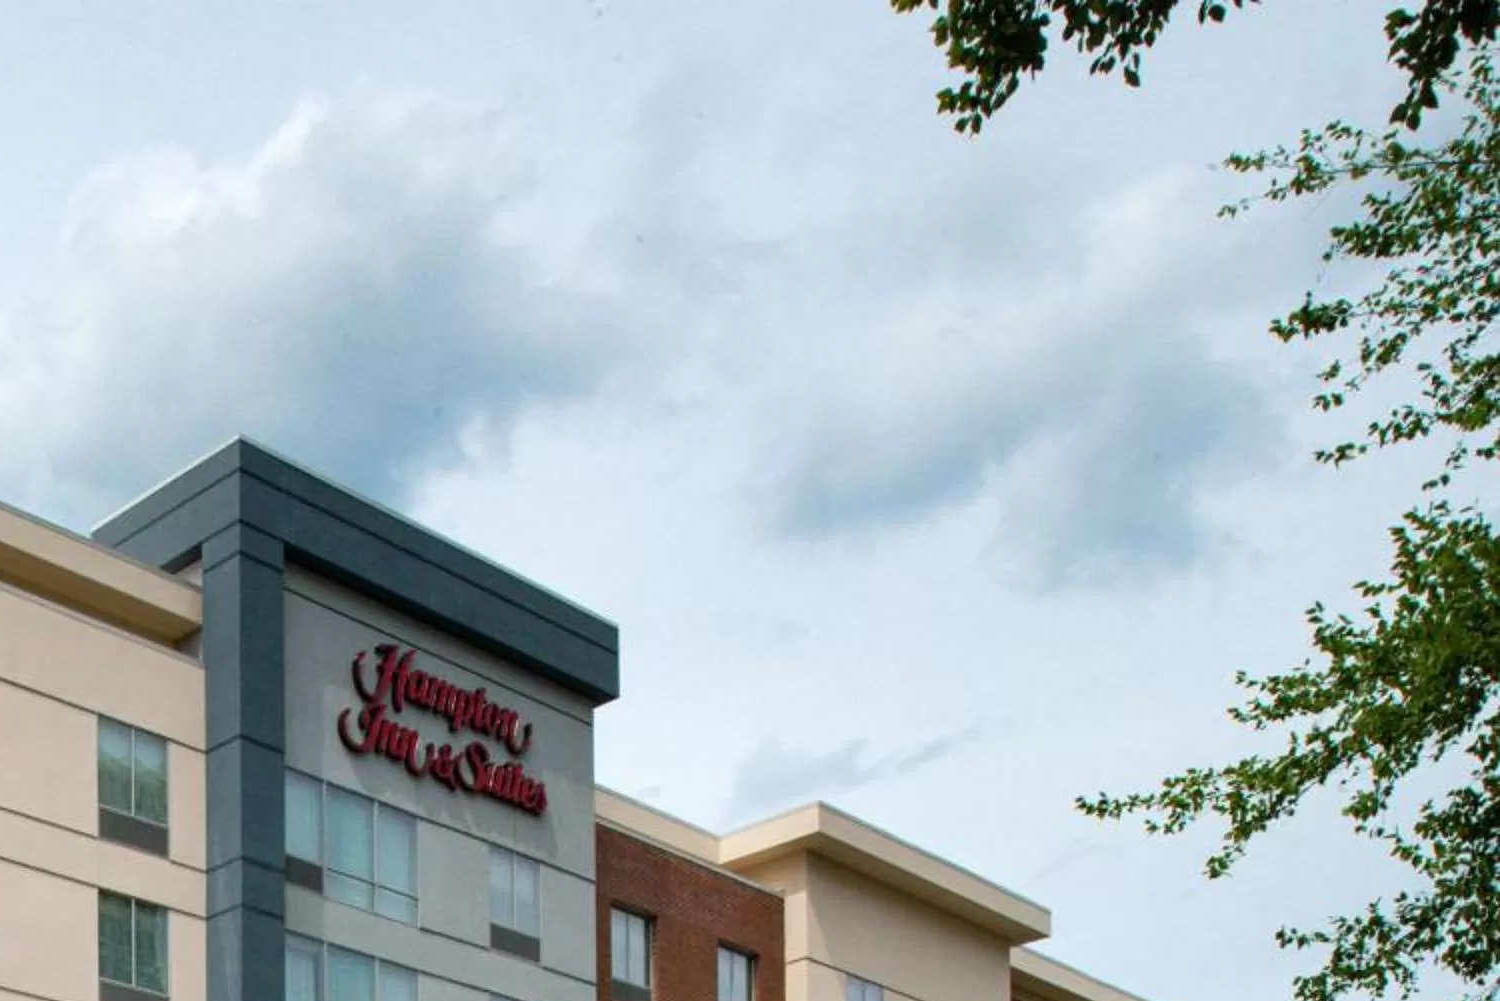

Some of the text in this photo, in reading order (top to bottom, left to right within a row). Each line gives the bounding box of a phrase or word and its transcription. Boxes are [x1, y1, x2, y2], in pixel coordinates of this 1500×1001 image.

[352, 643, 532, 755] Hampton
[338, 703, 548, 817] Inn & Suites
